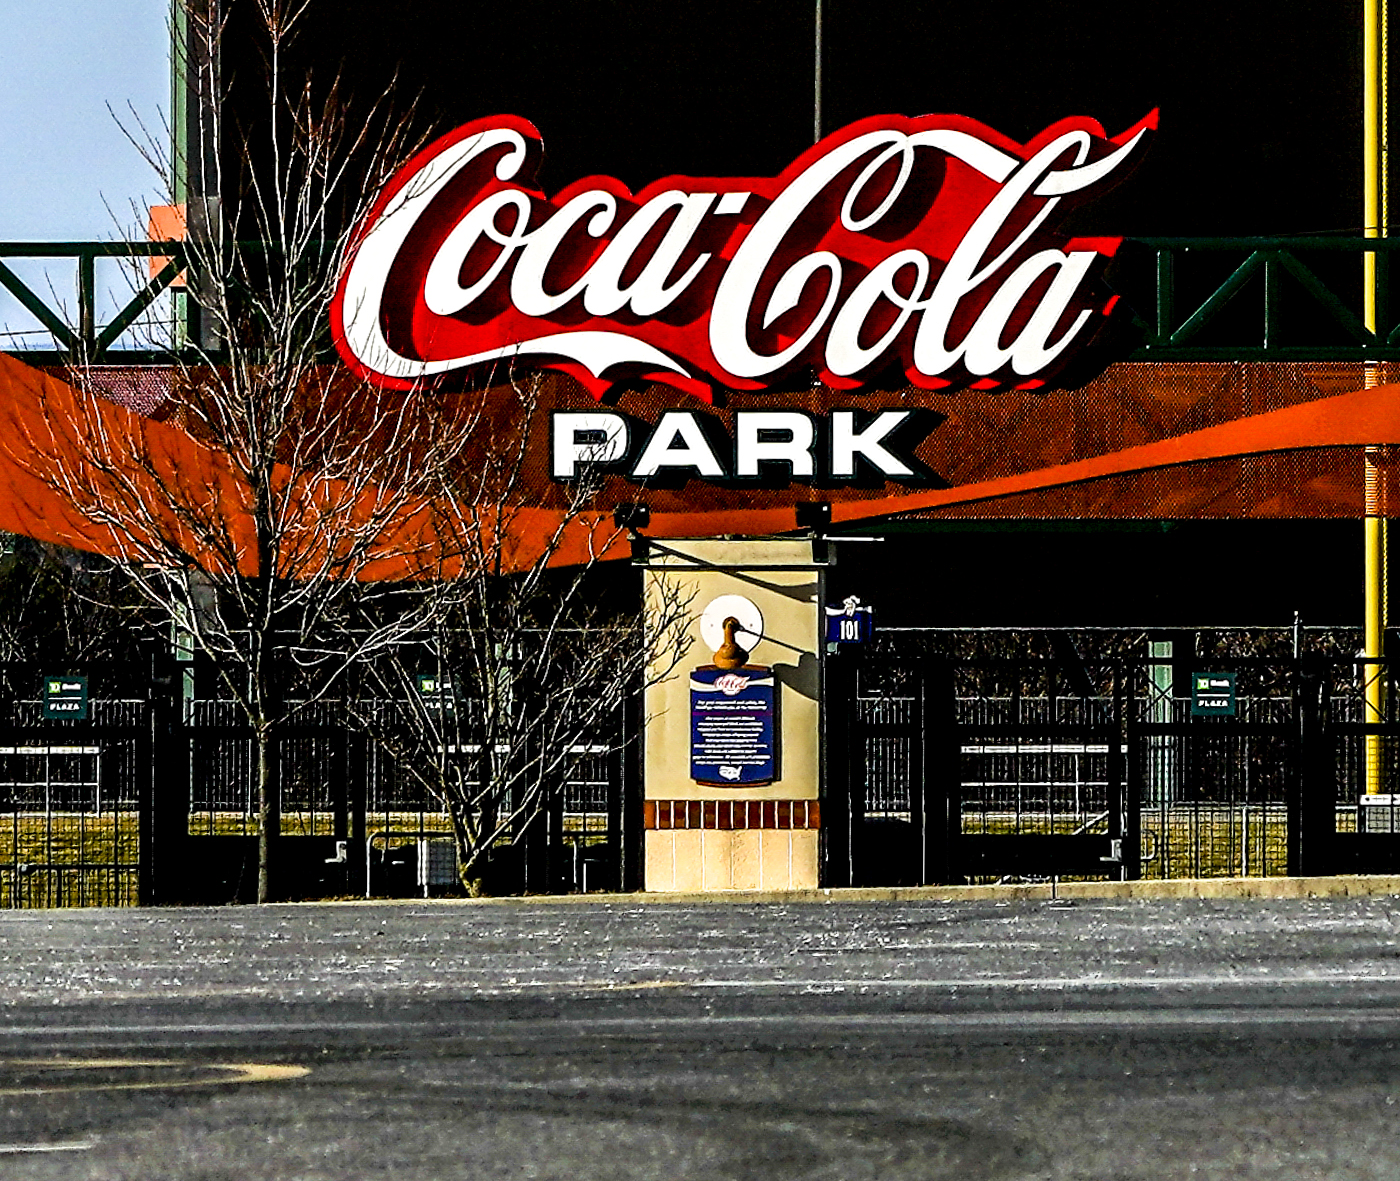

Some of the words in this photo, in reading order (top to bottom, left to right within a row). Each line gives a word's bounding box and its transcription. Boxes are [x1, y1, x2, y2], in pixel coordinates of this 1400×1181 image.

[341, 125, 1148, 380] Coca-Cola
[553, 411, 914, 477] PARK
[840, 620, 859, 640] 101
